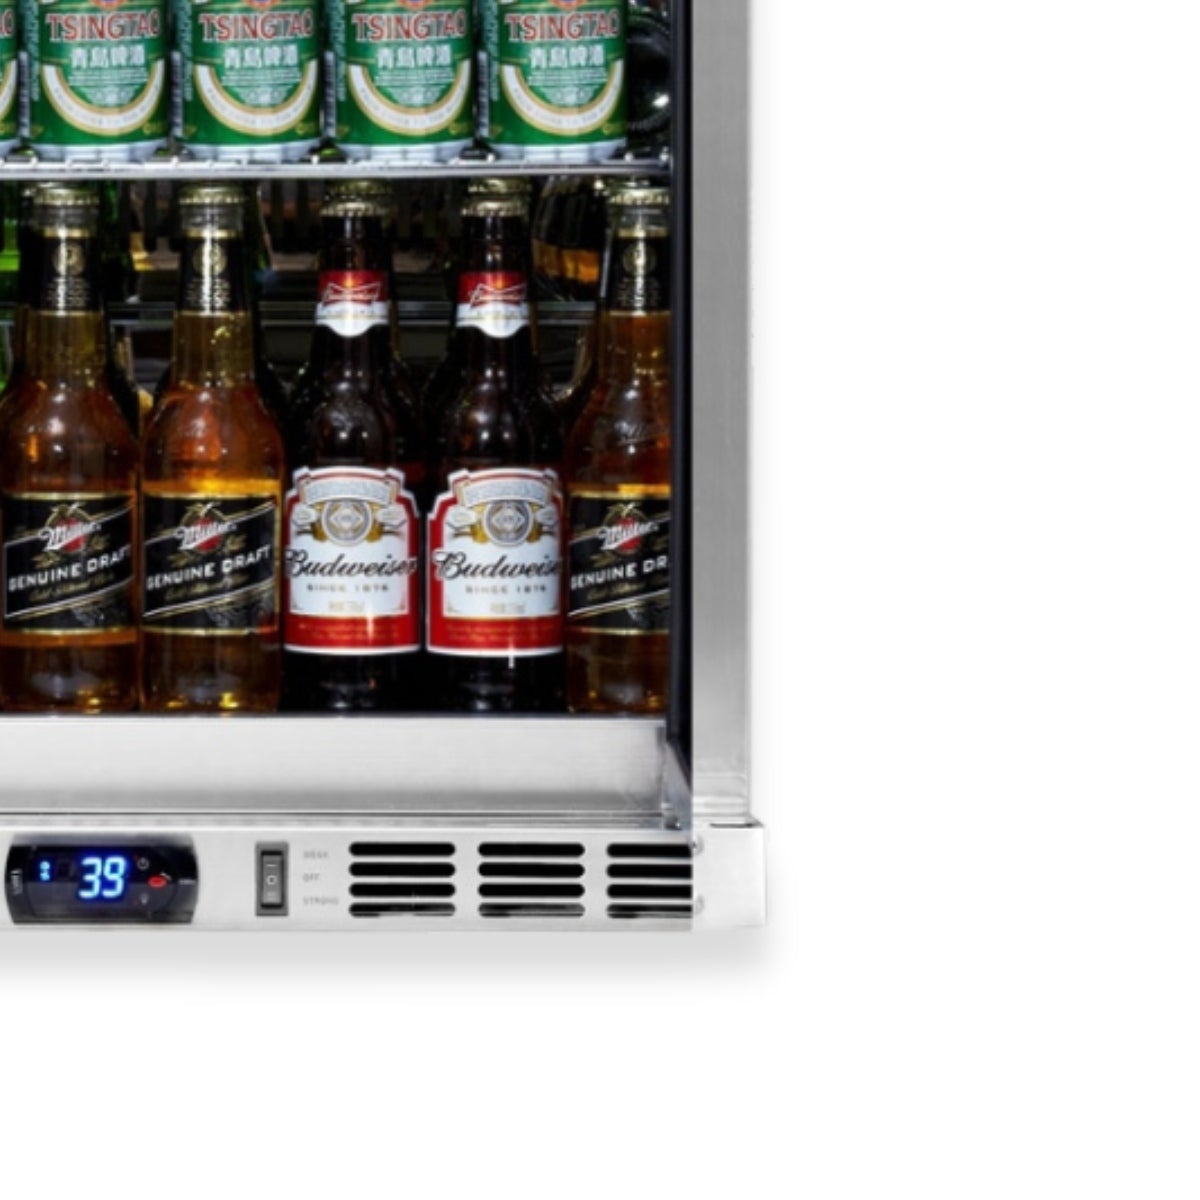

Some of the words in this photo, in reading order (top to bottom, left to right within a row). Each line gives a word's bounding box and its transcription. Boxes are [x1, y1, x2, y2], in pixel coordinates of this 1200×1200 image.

[46, 10, 160, 42] TSINGTAO
[200, 10, 313, 42] TSINGTAO
[352, 10, 467, 42] TSINGTAO
[504, 10, 621, 42] TSINGTAO
[8, 561, 82, 592] GENUINE
[146, 562, 215, 590] GENUINE
[221, 543, 271, 574] DRAFT
[570, 561, 637, 591] GENUINE
[78, 856, 127, 899] 39
